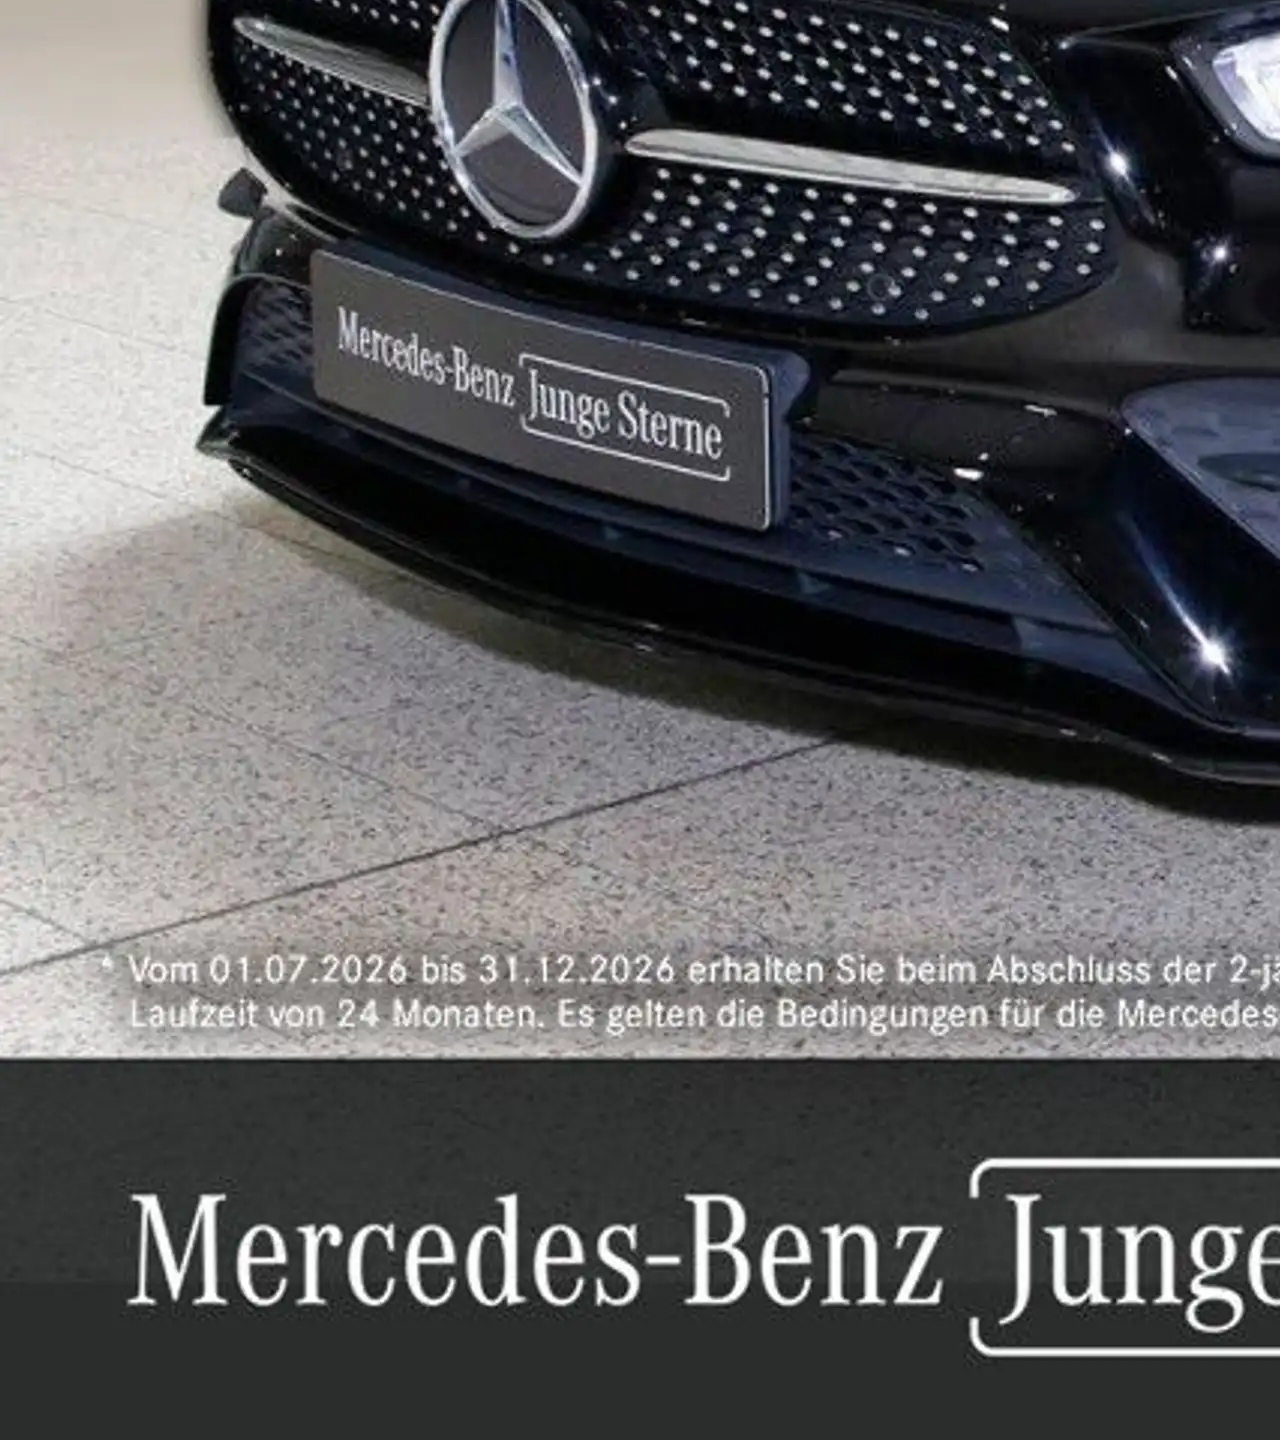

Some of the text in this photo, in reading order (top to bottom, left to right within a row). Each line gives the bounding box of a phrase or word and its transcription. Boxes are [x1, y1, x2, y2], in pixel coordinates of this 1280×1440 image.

[337, 305, 723, 461] Mercedes-Benz Junge Sterne
